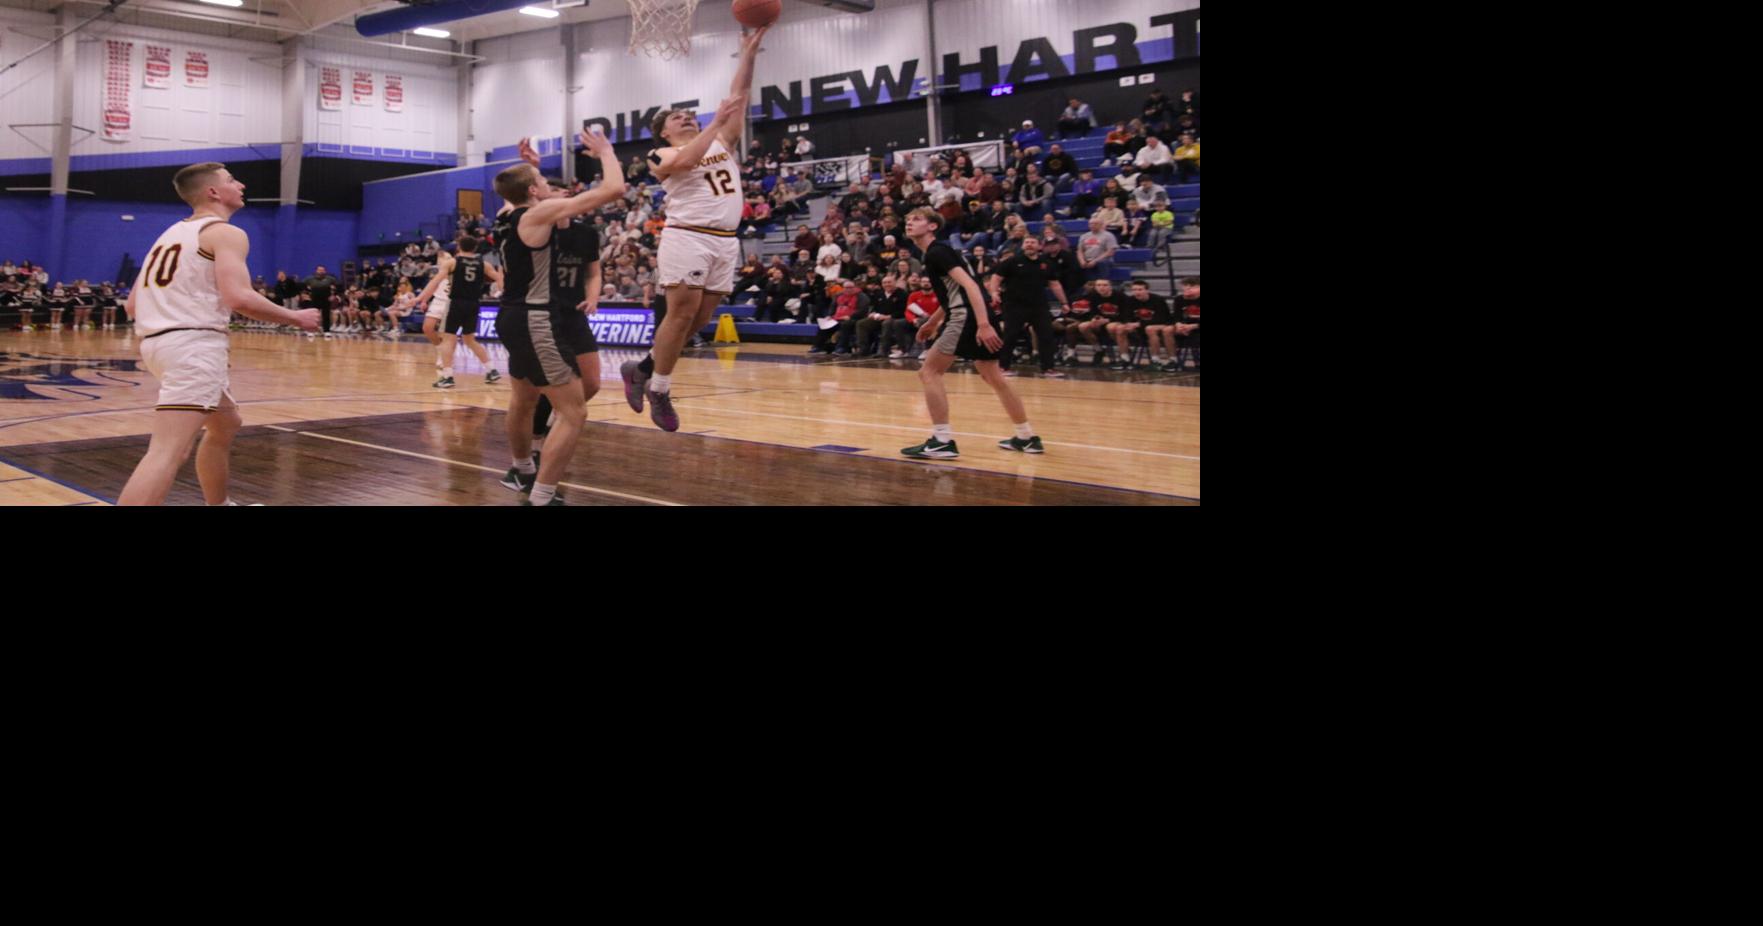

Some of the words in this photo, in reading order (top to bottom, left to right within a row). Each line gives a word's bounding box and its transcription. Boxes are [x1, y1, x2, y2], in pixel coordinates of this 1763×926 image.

[583, 99, 699, 144] DIK
[760, 59, 919, 119] NEW
[943, 8, 1200, 92] HART
[703, 169, 736, 196] 12
[143, 243, 182, 288] 10
[464, 265, 477, 282] 5
[556, 266, 578, 288] 21
[588, 322, 656, 344] VERINE
